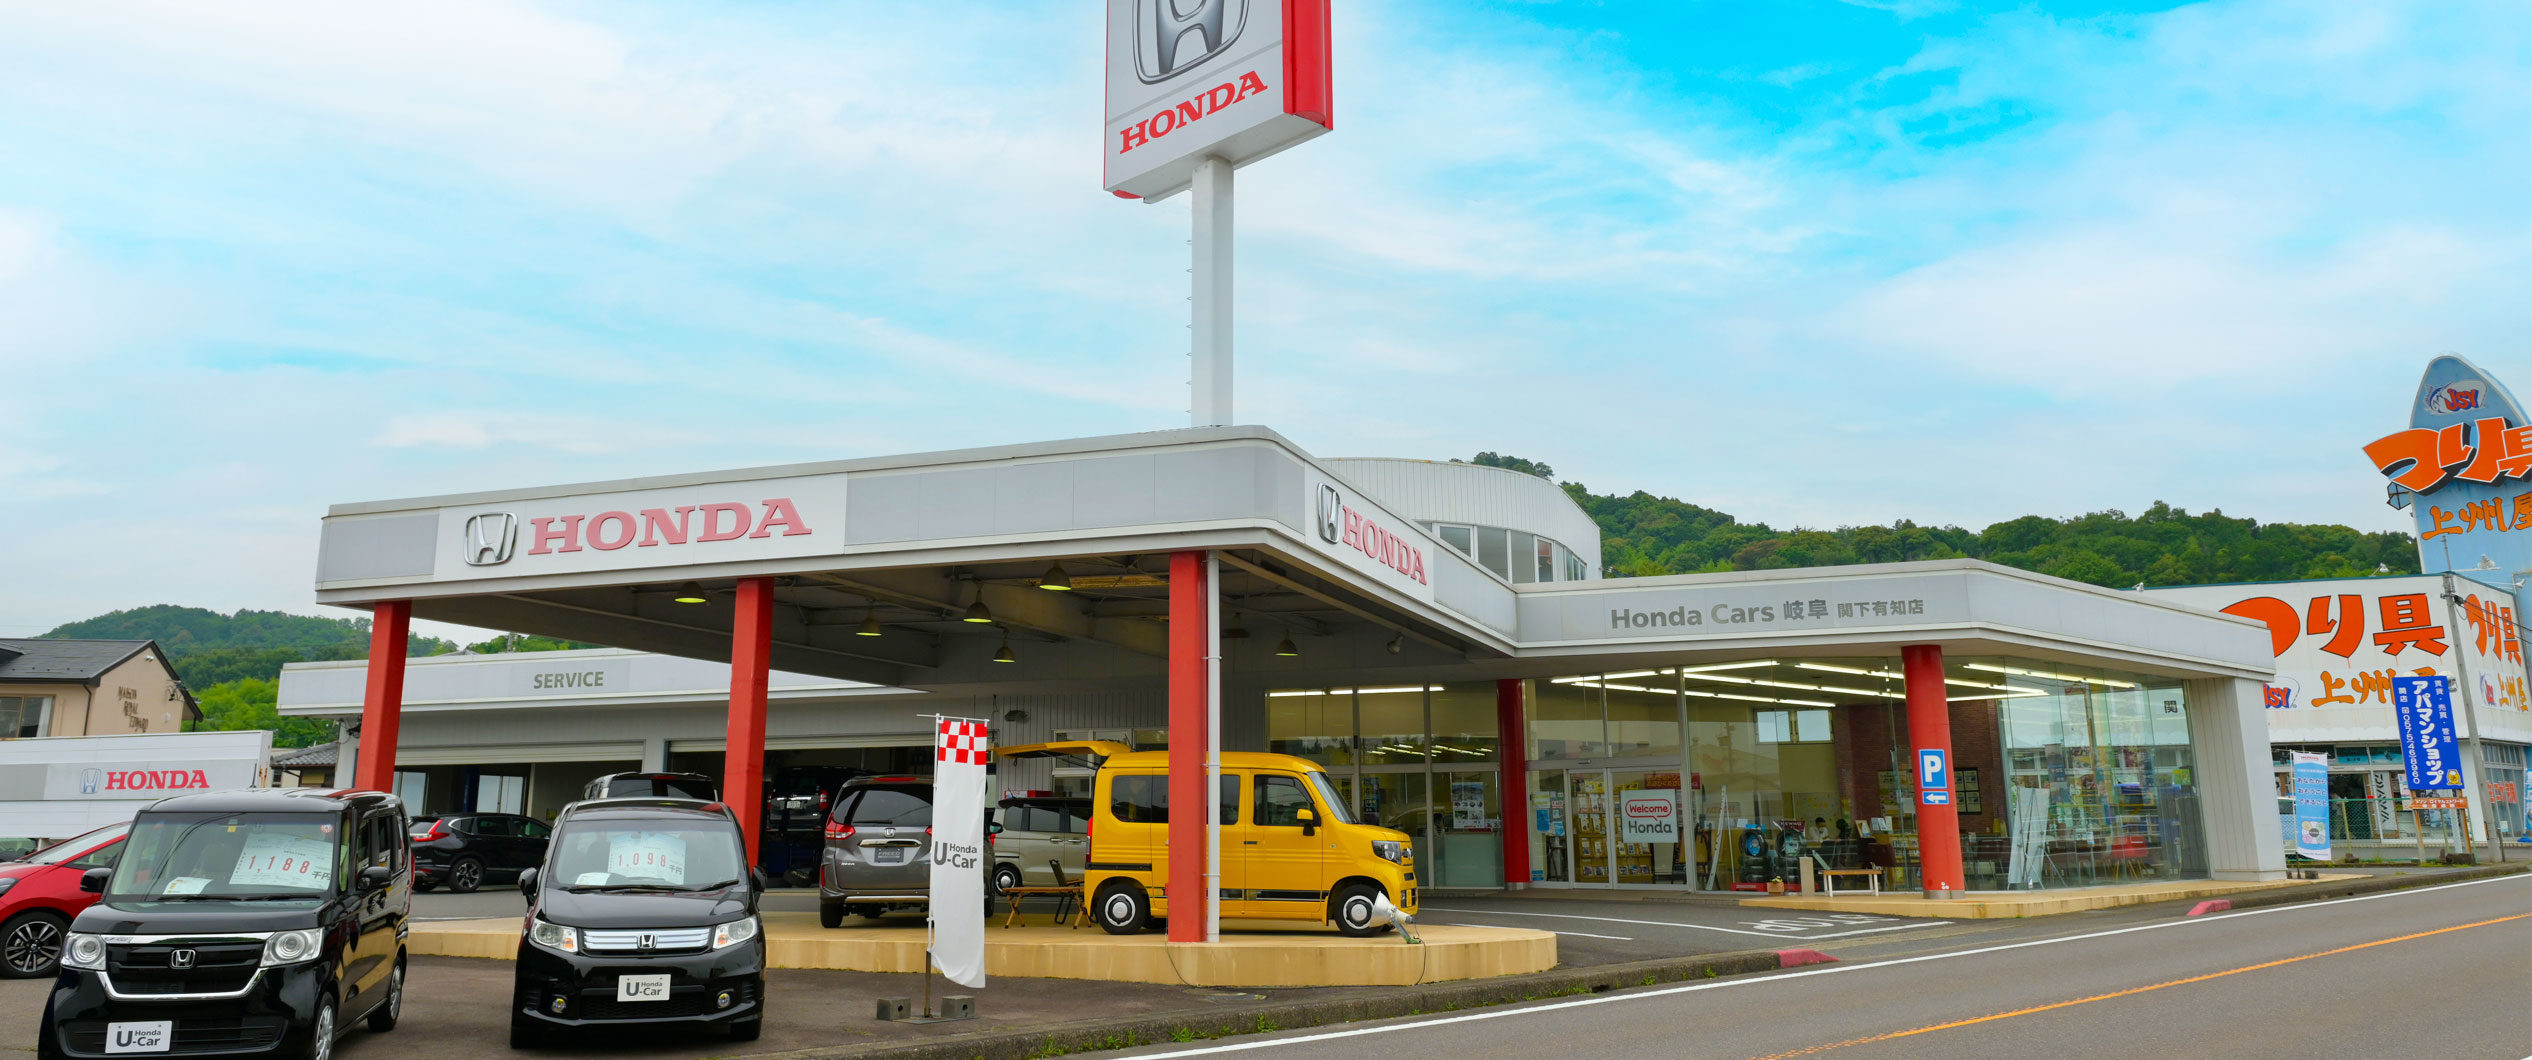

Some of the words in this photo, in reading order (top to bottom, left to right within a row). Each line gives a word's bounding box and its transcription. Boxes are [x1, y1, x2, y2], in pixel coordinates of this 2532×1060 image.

[1119, 70, 1268, 155] HONDA
[2443, 387, 2479, 412] JSY
[527, 497, 813, 556] HONDA
[1342, 504, 1428, 586] HONDA
[1611, 606, 1702, 629] Honda
[1711, 603, 1775, 624] Cars
[1783, 599, 1829, 620] 岐阜
[2464, 593, 2522, 667] つり具
[533, 671, 605, 689] SERVICE
[2311, 666, 2437, 707] 上州
[2412, 680, 2444, 786] アパマンショップ
[105, 769, 211, 790] HONDA
[1923, 755, 1942, 783] P
[1629, 803, 1669, 814] Welcome
[1628, 820, 1672, 834] Honda
[934, 841, 977, 869] U-Car
[949, 843, 977, 853] Honda
[248, 855, 311, 874] 1,188
[626, 982, 662, 997] U-Car
[116, 1030, 161, 1047] U-Car
